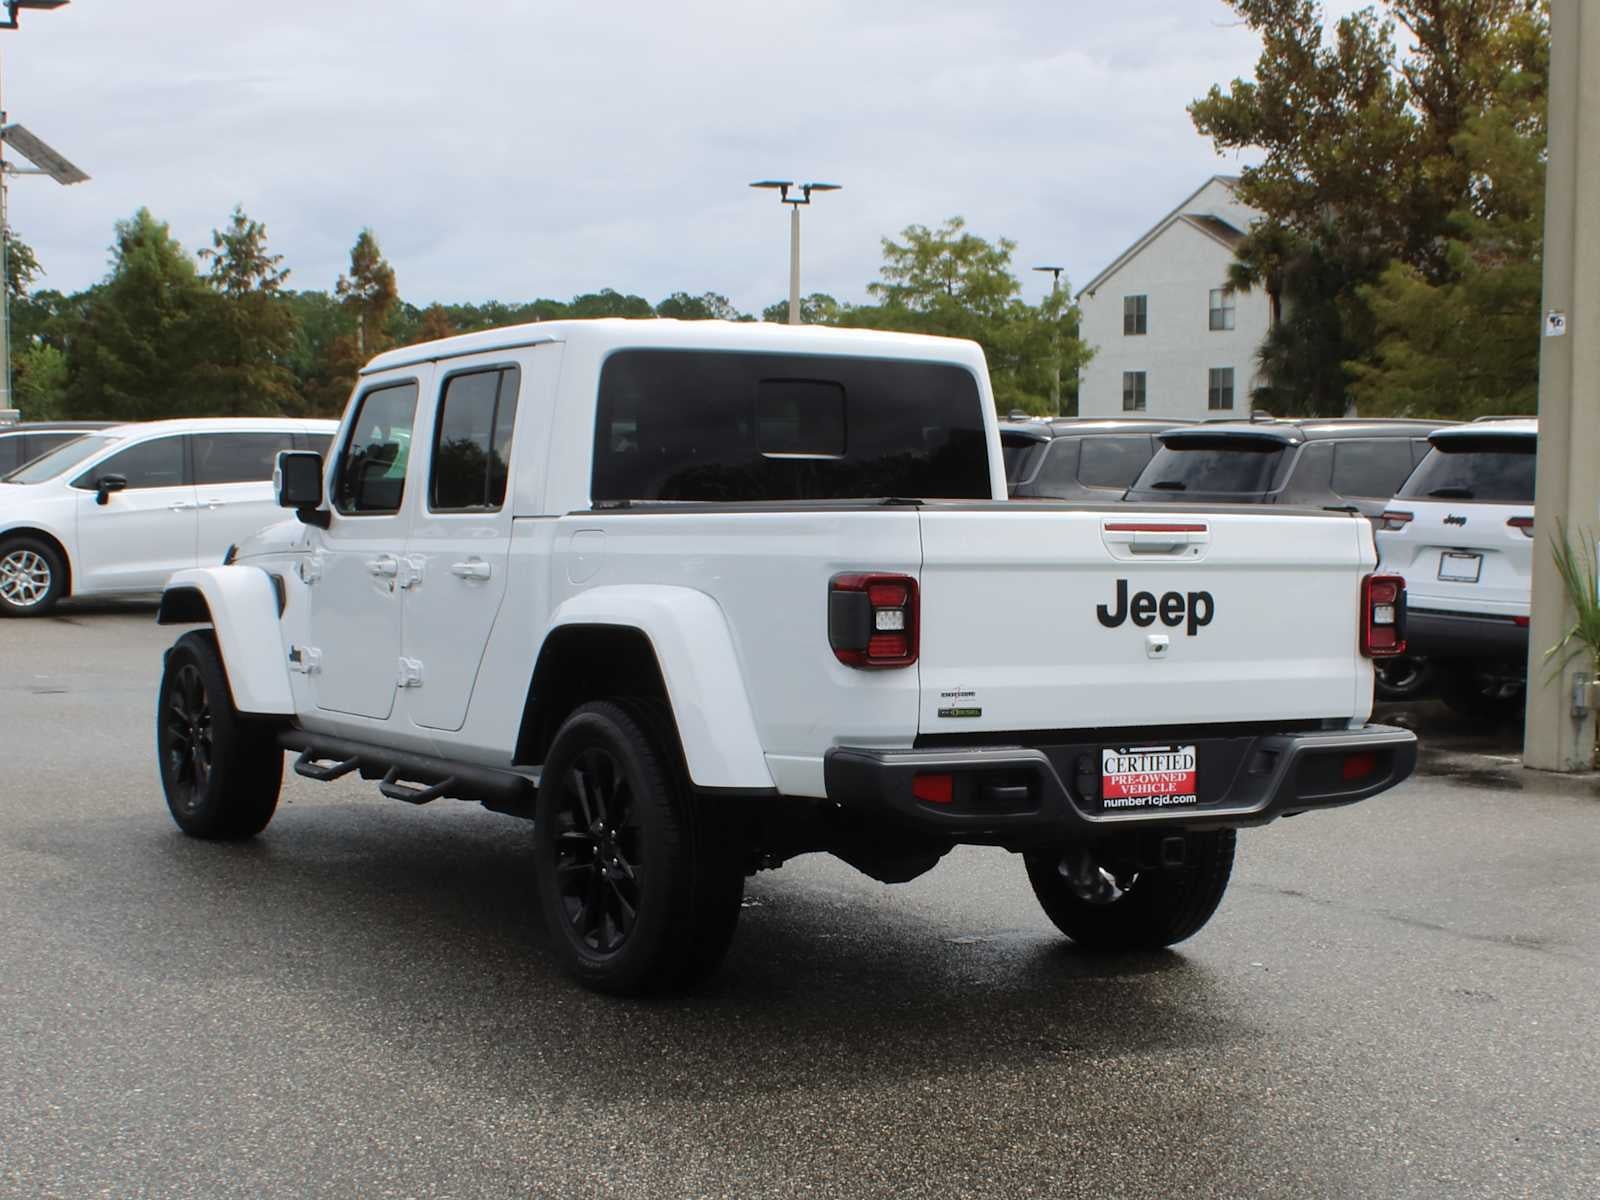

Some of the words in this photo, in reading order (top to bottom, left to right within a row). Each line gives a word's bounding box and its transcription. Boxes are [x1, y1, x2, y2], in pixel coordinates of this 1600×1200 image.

[1097, 578, 1214, 636] Jeep
[1104, 754, 1194, 774] CERTIFIED
[1111, 773, 1187, 785] PRE-OWNED
[1121, 783, 1177, 794] VEHICLE
[1103, 795, 1197, 808] number1cjd.com
